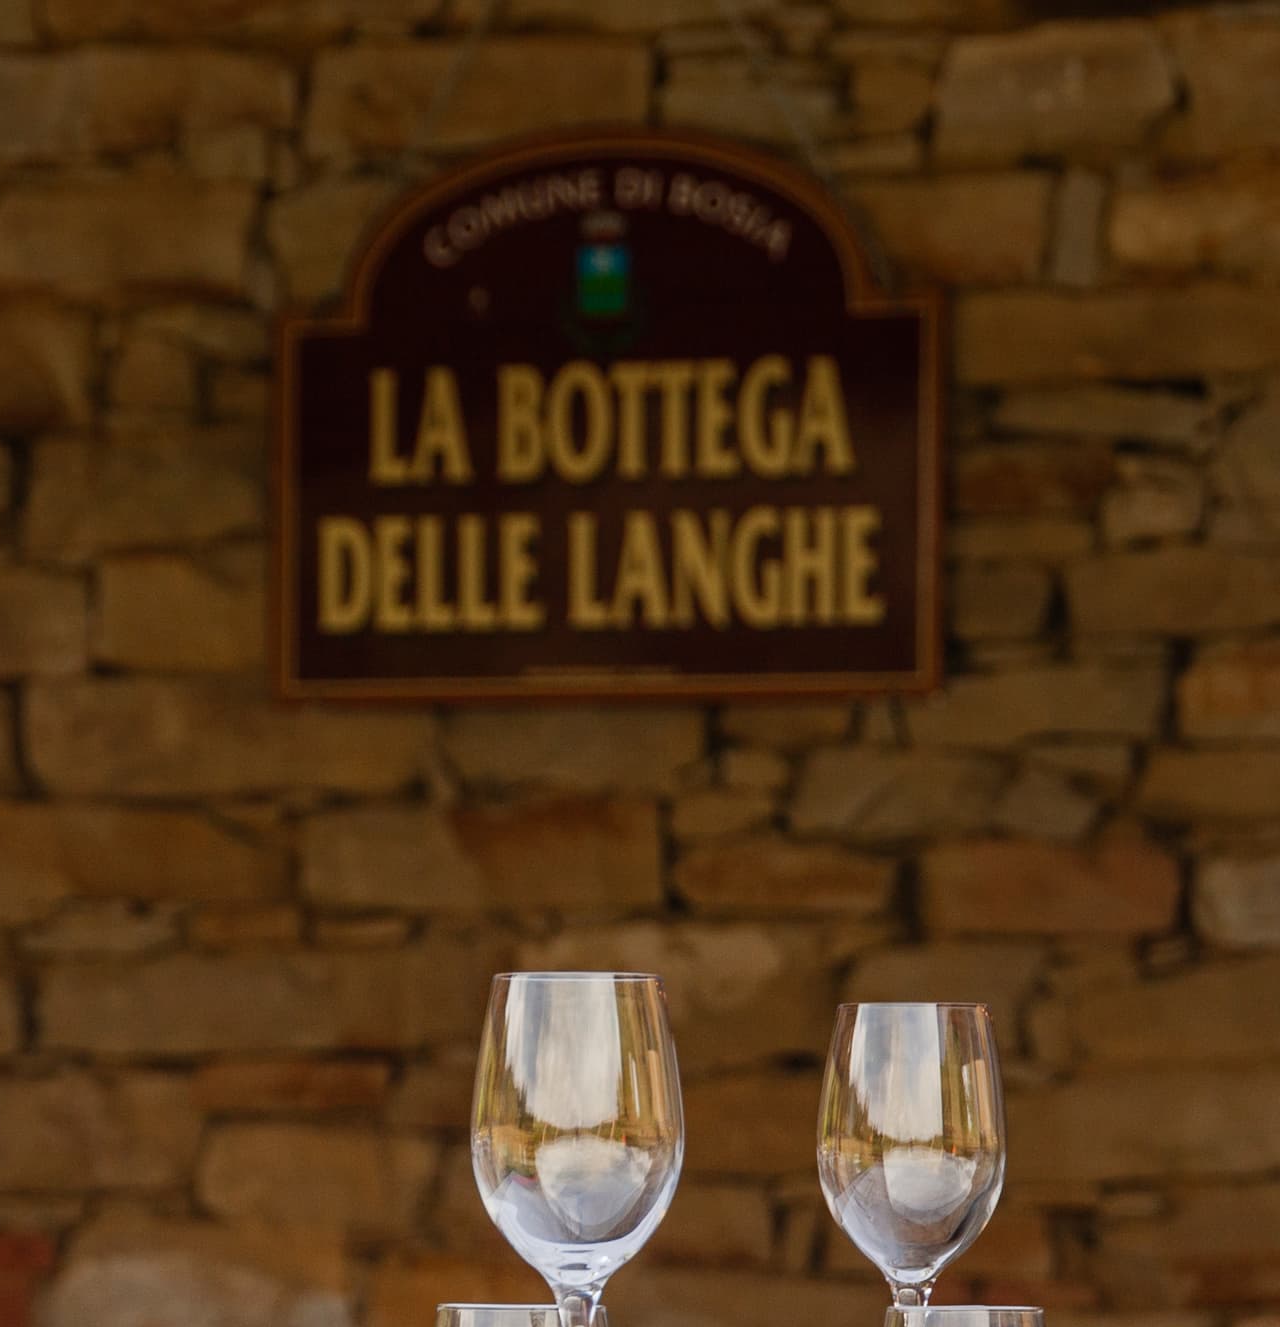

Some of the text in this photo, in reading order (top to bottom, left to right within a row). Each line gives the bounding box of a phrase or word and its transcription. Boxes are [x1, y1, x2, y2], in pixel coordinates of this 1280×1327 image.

[424, 168, 602, 267] COMUNE
[615, 167, 664, 209] DI
[370, 355, 855, 484] LA BOTTEGA
[320, 504, 884, 633] DELLE LANGHE
